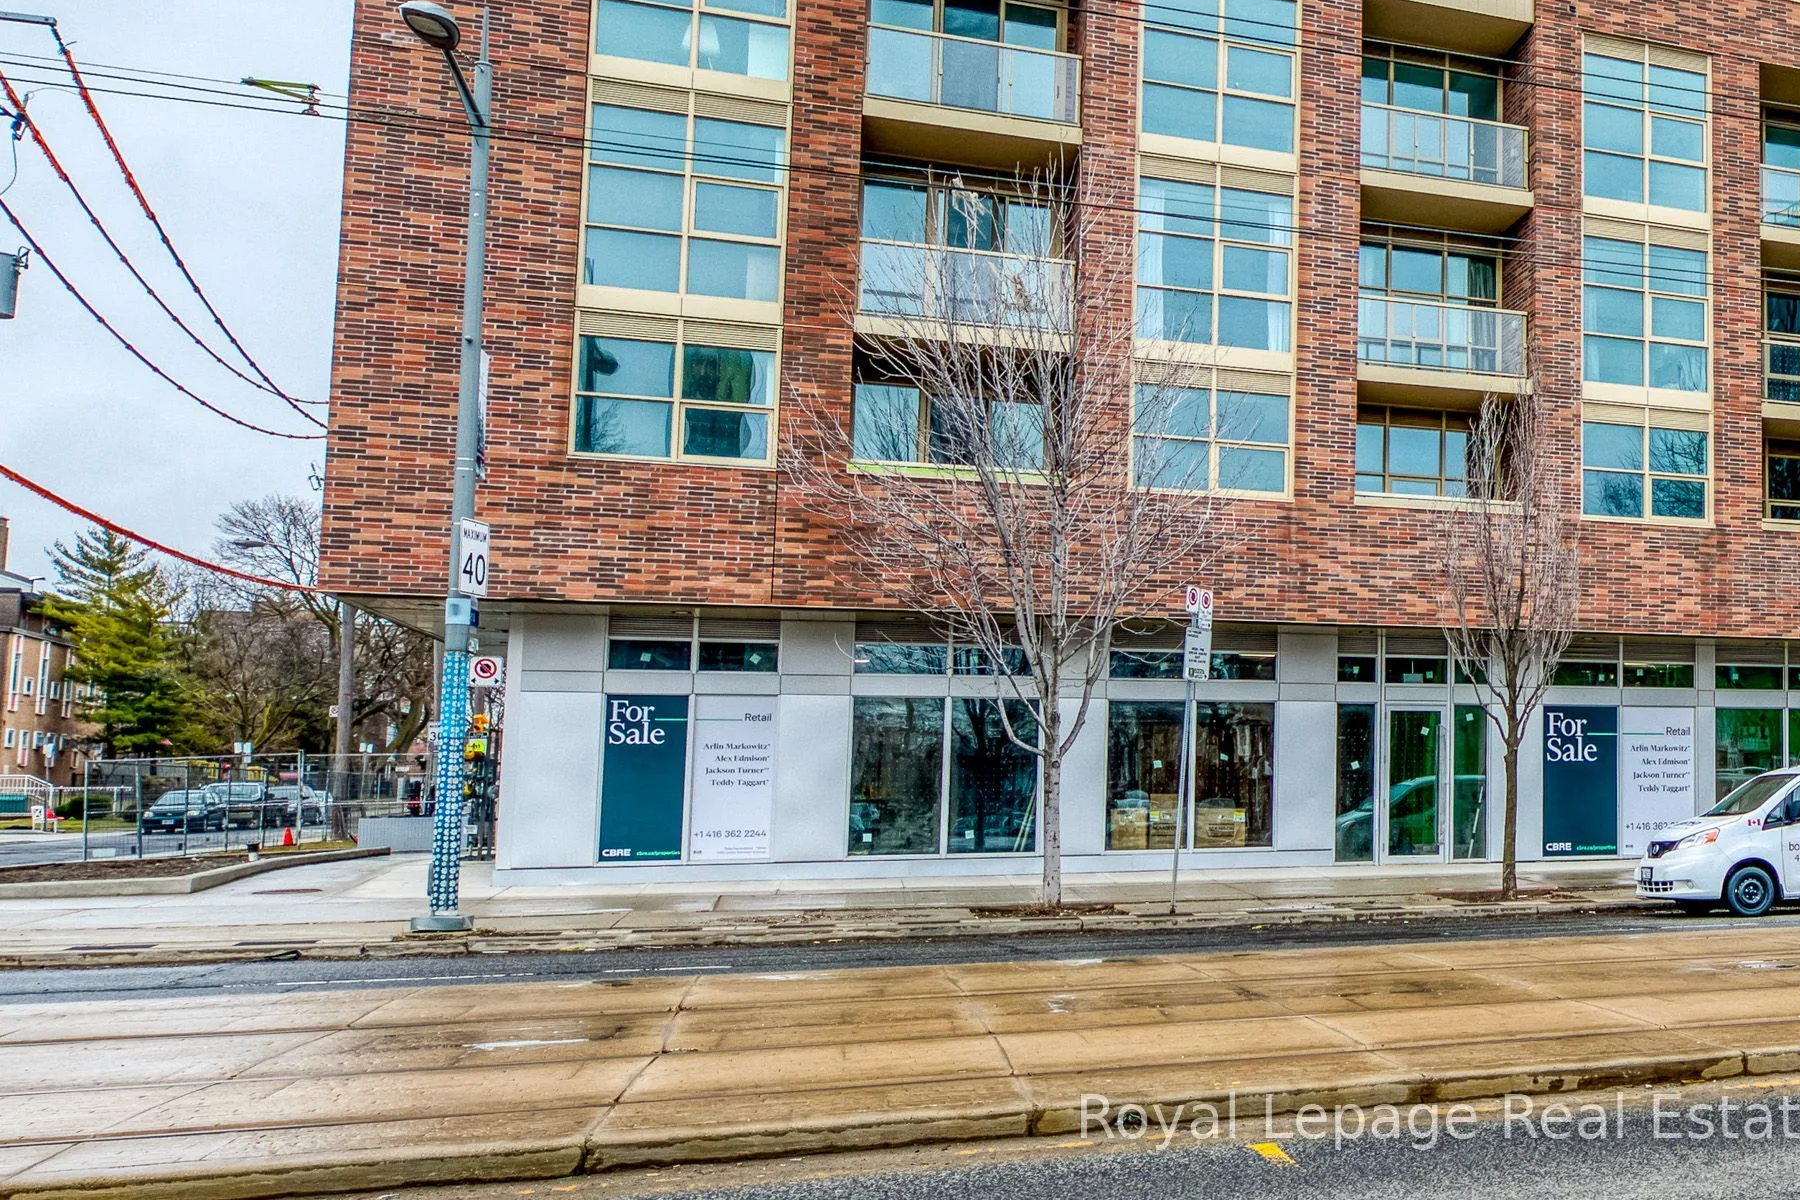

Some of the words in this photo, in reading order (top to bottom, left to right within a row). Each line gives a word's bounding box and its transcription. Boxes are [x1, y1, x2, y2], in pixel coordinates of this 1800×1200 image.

[463, 527, 487, 542] MAXIMUM
[462, 552, 486, 586] 40
[609, 700, 656, 722] For
[744, 713, 772, 722] Retail
[1546, 712, 1587, 736] For
[608, 722, 666, 745] Sale
[1665, 726, 1691, 736] Retail
[1546, 737, 1598, 762] Sale
[705, 767, 736, 775] Jackson
[1633, 771, 1660, 779] Jackson
[711, 779, 735, 787] Teddy
[1638, 785, 1660, 793] Teddy
[1625, 822, 1634, 831] +1
[1635, 822, 1651, 831] 416
[705, 830, 722, 838] 416
[724, 829, 742, 838] 362
[744, 829, 767, 838] 2244
[1545, 842, 1572, 851] CBRE
[602, 848, 632, 857] CBRE
